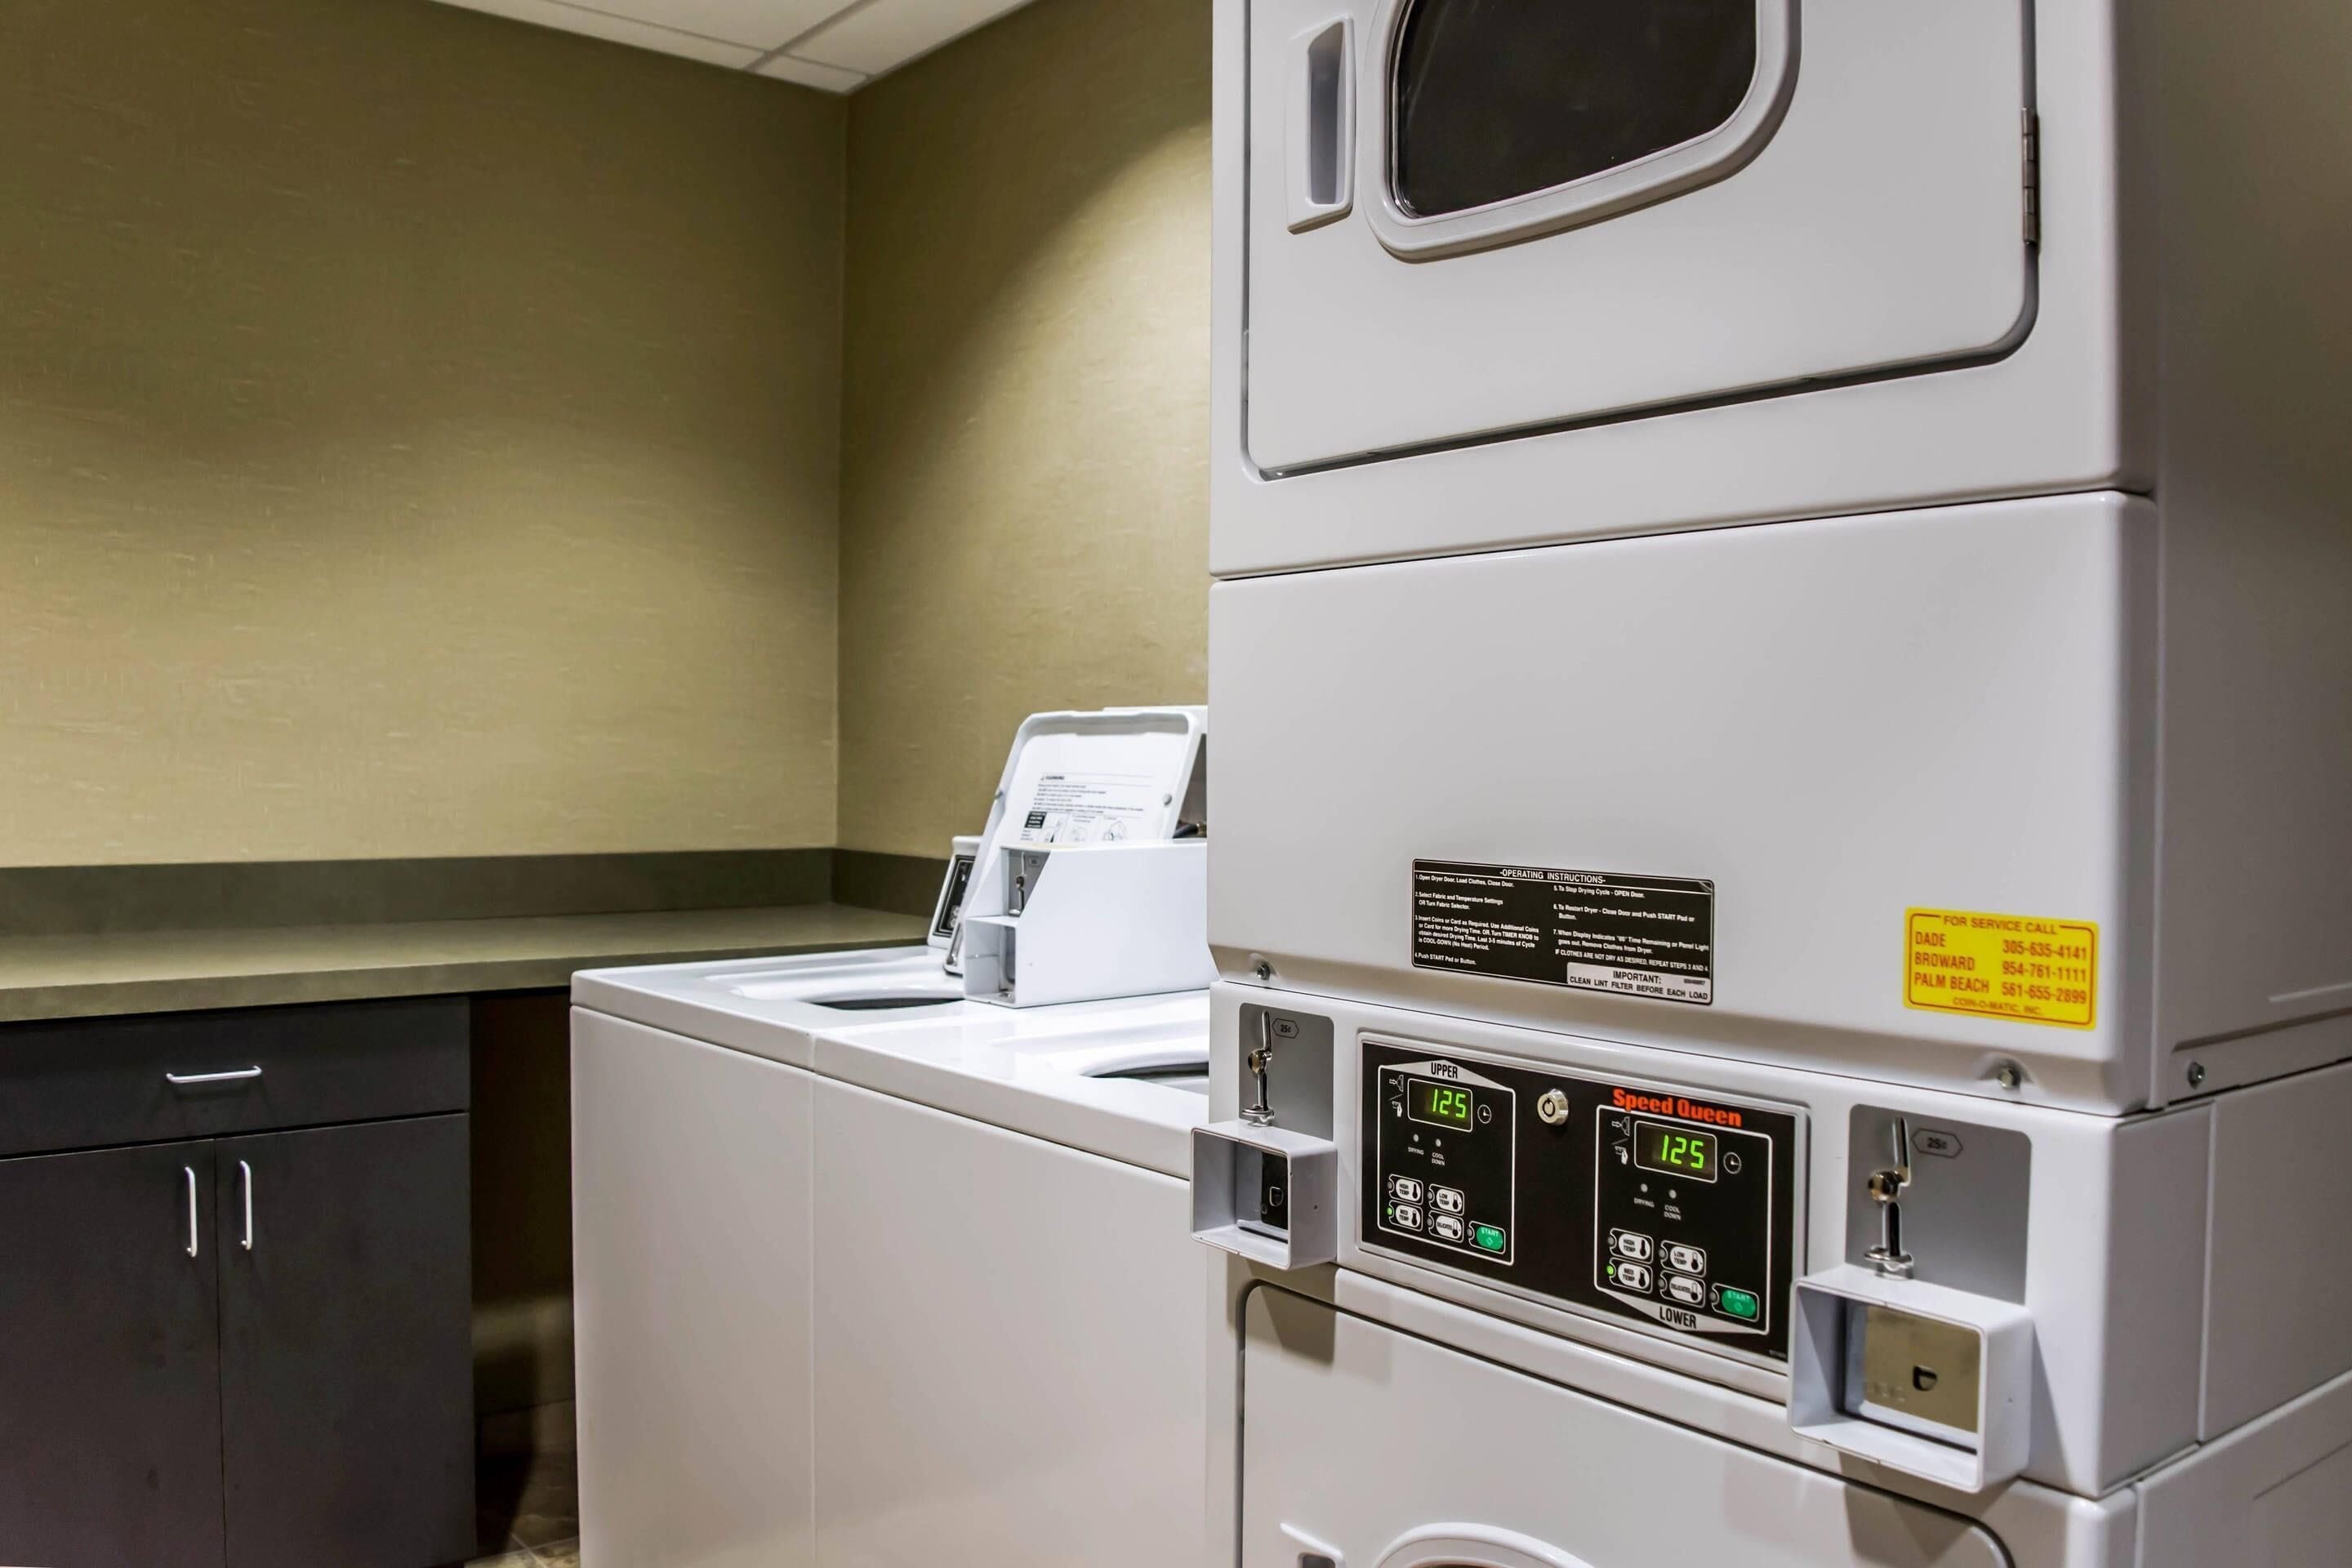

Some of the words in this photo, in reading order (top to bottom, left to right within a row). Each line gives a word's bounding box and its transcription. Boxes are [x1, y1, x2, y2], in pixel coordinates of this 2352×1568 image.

[1944, 915, 1968, 928] FOR
[1971, 917, 2022, 932] SERVICE
[2025, 922, 2058, 935] CALL
[1915, 931, 1946, 947] DADE
[2002, 939, 2087, 960] 305-635-4141
[1613, 970, 1661, 985] IMPORTANT:
[1914, 951, 1976, 971] BROWARD
[2002, 960, 2087, 982] 954-761-1111
[1570, 976, 1591, 986] CLEAN
[1594, 978, 1609, 988] LINT
[1611, 982, 1633, 991] FILTER
[1636, 984, 1664, 995] BEFORE
[1667, 987, 1686, 997] EACH
[1689, 991, 1708, 1000] LOAD
[1914, 972, 1946, 988] PALM
[1949, 975, 1990, 994] BEACH
[1431, 1062, 1458, 1079] UPPER
[1432, 1089, 1467, 1118] 125
[1613, 1088, 1673, 1111] Speed
[1677, 1098, 1742, 1127] Queen
[1661, 1134, 1704, 1169] 125
[1481, 1227, 1499, 1237] START
[1727, 1290, 1751, 1302] START
[1659, 1307, 1697, 1330] LOWER
